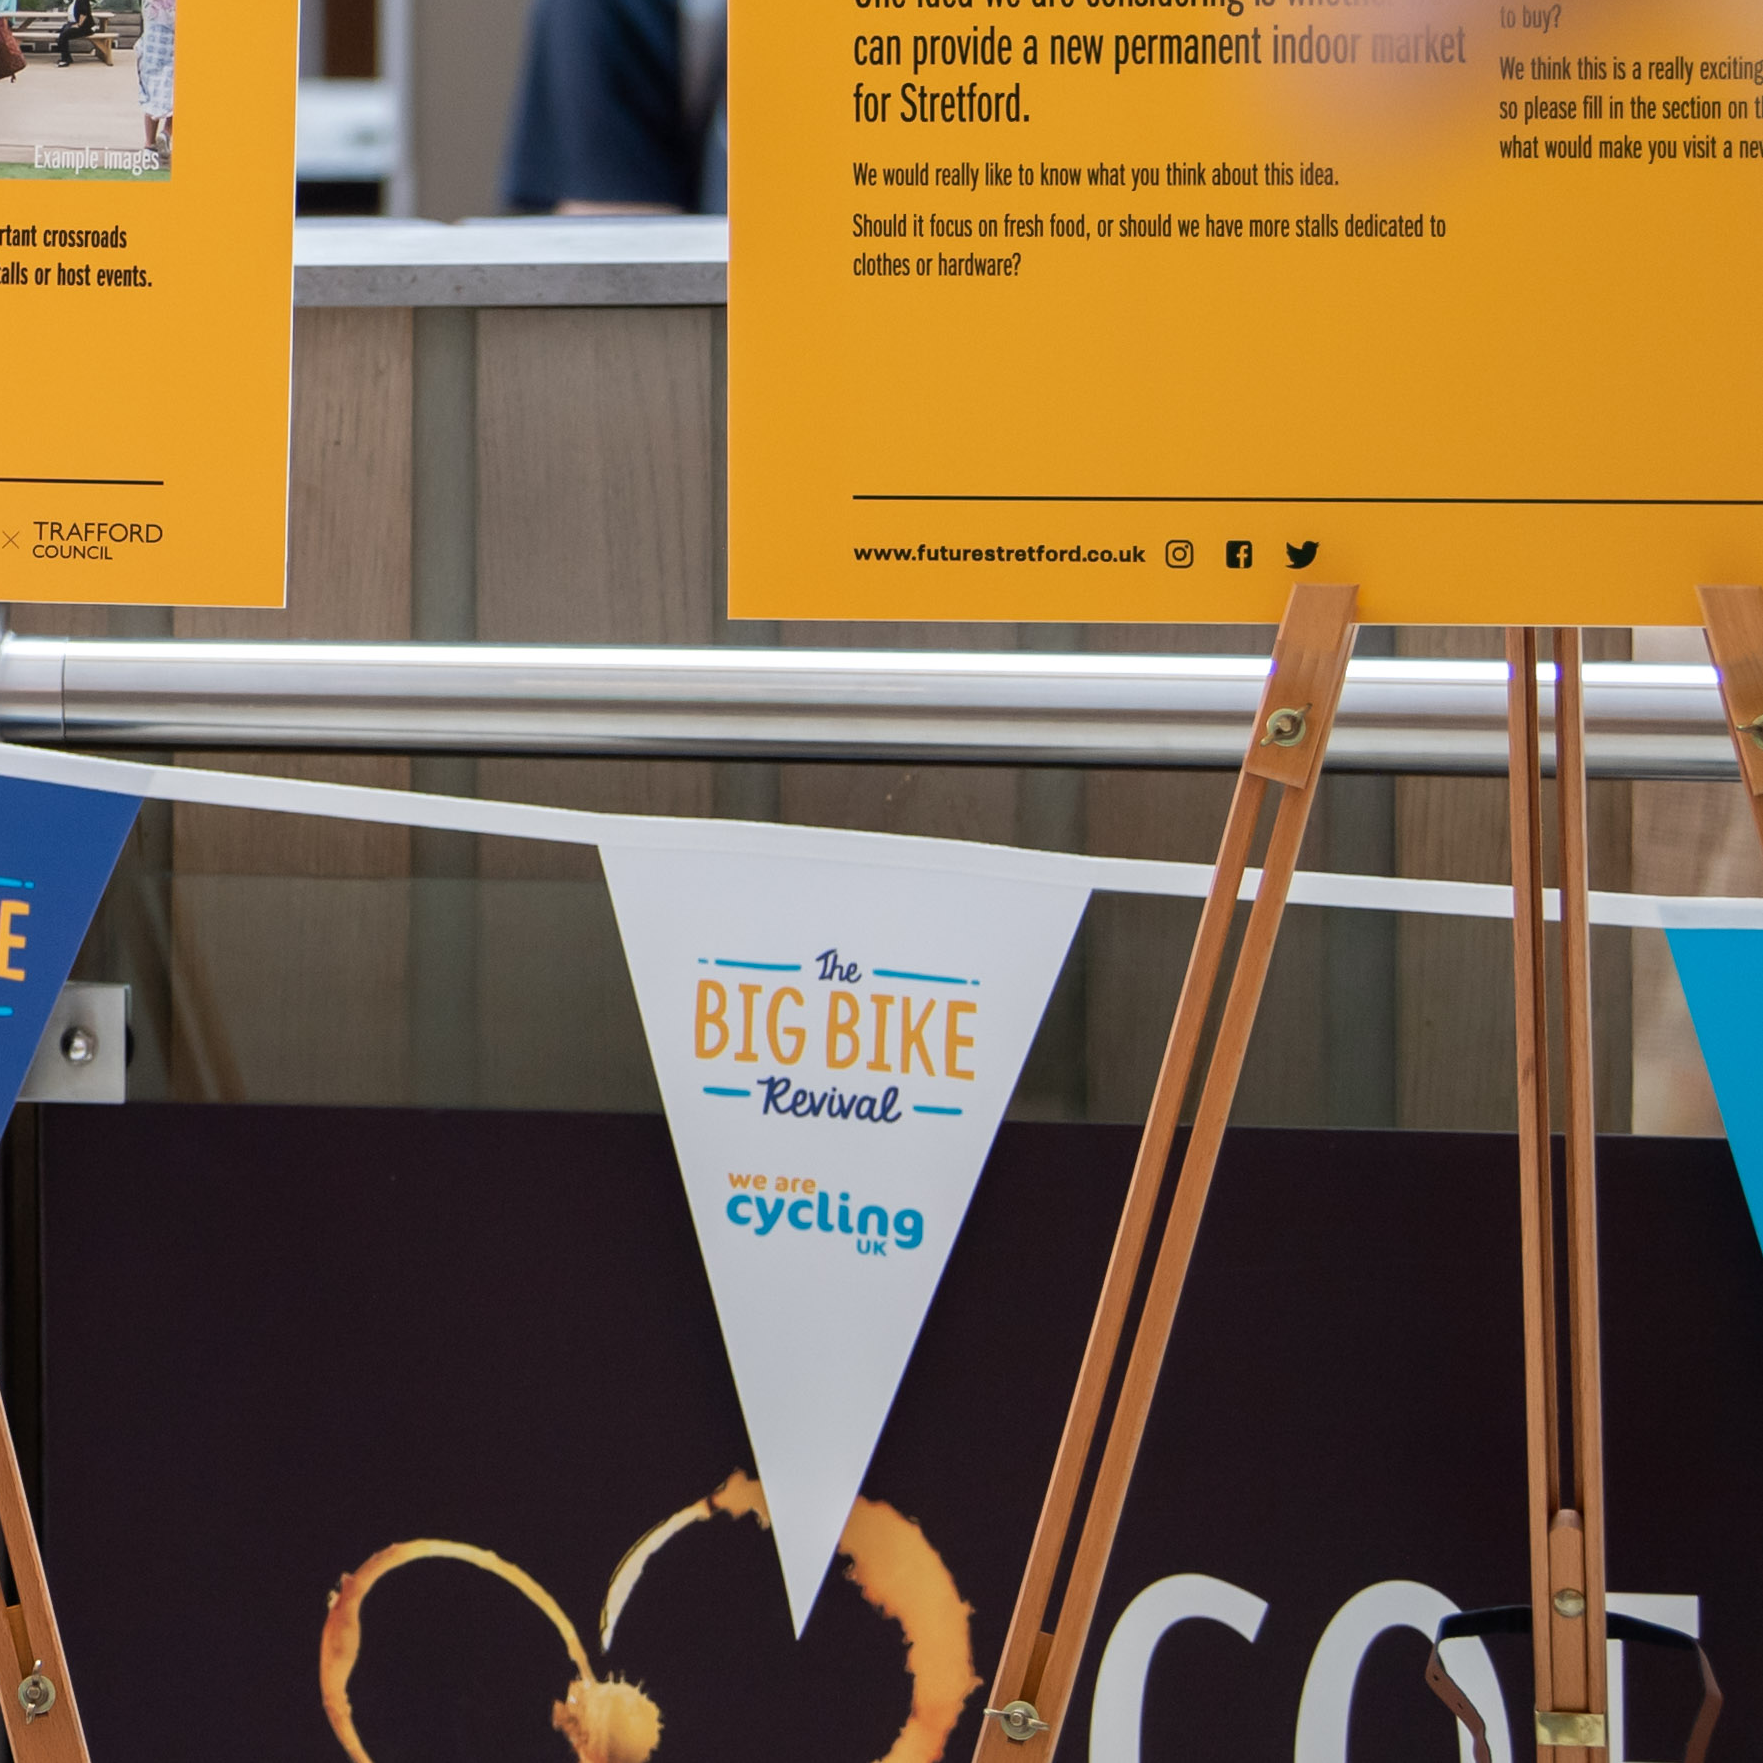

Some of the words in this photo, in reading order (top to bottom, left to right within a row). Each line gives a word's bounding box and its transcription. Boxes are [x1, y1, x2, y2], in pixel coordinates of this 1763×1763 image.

[854, 35, 900, 65] can
[913, 25, 1012, 75] provide
[1023, 34, 1037, 65] a
[1050, 34, 1103, 65] new
[1114, 27, 1261, 74] permanent
[1273, 23, 1361, 64] indoor
[1371, 26, 1466, 64] market
[1499, 56, 1524, 80] We
[1530, 55, 1571, 80] think
[1577, 55, 1607, 80] this
[1613, 56, 1626, 80] is
[1632, 61, 1641, 80] a
[1648, 55, 1693, 86] really
[853, 82, 891, 122] for
[900, 82, 1029, 122] Stretford.
[34, 144, 99, 176] Example
[103, 146, 160, 176] images
[853, 162, 877, 186] We
[882, 162, 928, 186] would
[935, 162, 979, 191] really
[985, 162, 1012, 186] like
[1018, 164, 1033, 185] to
[1040, 162, 1081, 185] know
[1087, 162, 1125, 185] what
[1131, 167, 1159, 191] you
[1166, 162, 1206, 185] think
[1212, 162, 1258, 185] about
[1264, 162, 1293, 185] this
[1300, 161, 1338, 185] idea.
[43, 223, 127, 248] crossroads
[32, 521, 164, 544] TRAFFORD
[32, 544, 112, 561] COUNCIL
[853, 542, 1146, 564] www.futurestretford.co.uk
[814, 948, 863, 984] The
[694, 978, 808, 1066] BIG
[825, 990, 978, 1082] BIKE
[756, 1075, 903, 1124] Revival
[727, 1172, 768, 1191] we
[774, 1175, 817, 1195] are
[725, 1190, 925, 1251] cycling
[856, 1238, 888, 1257] UK
